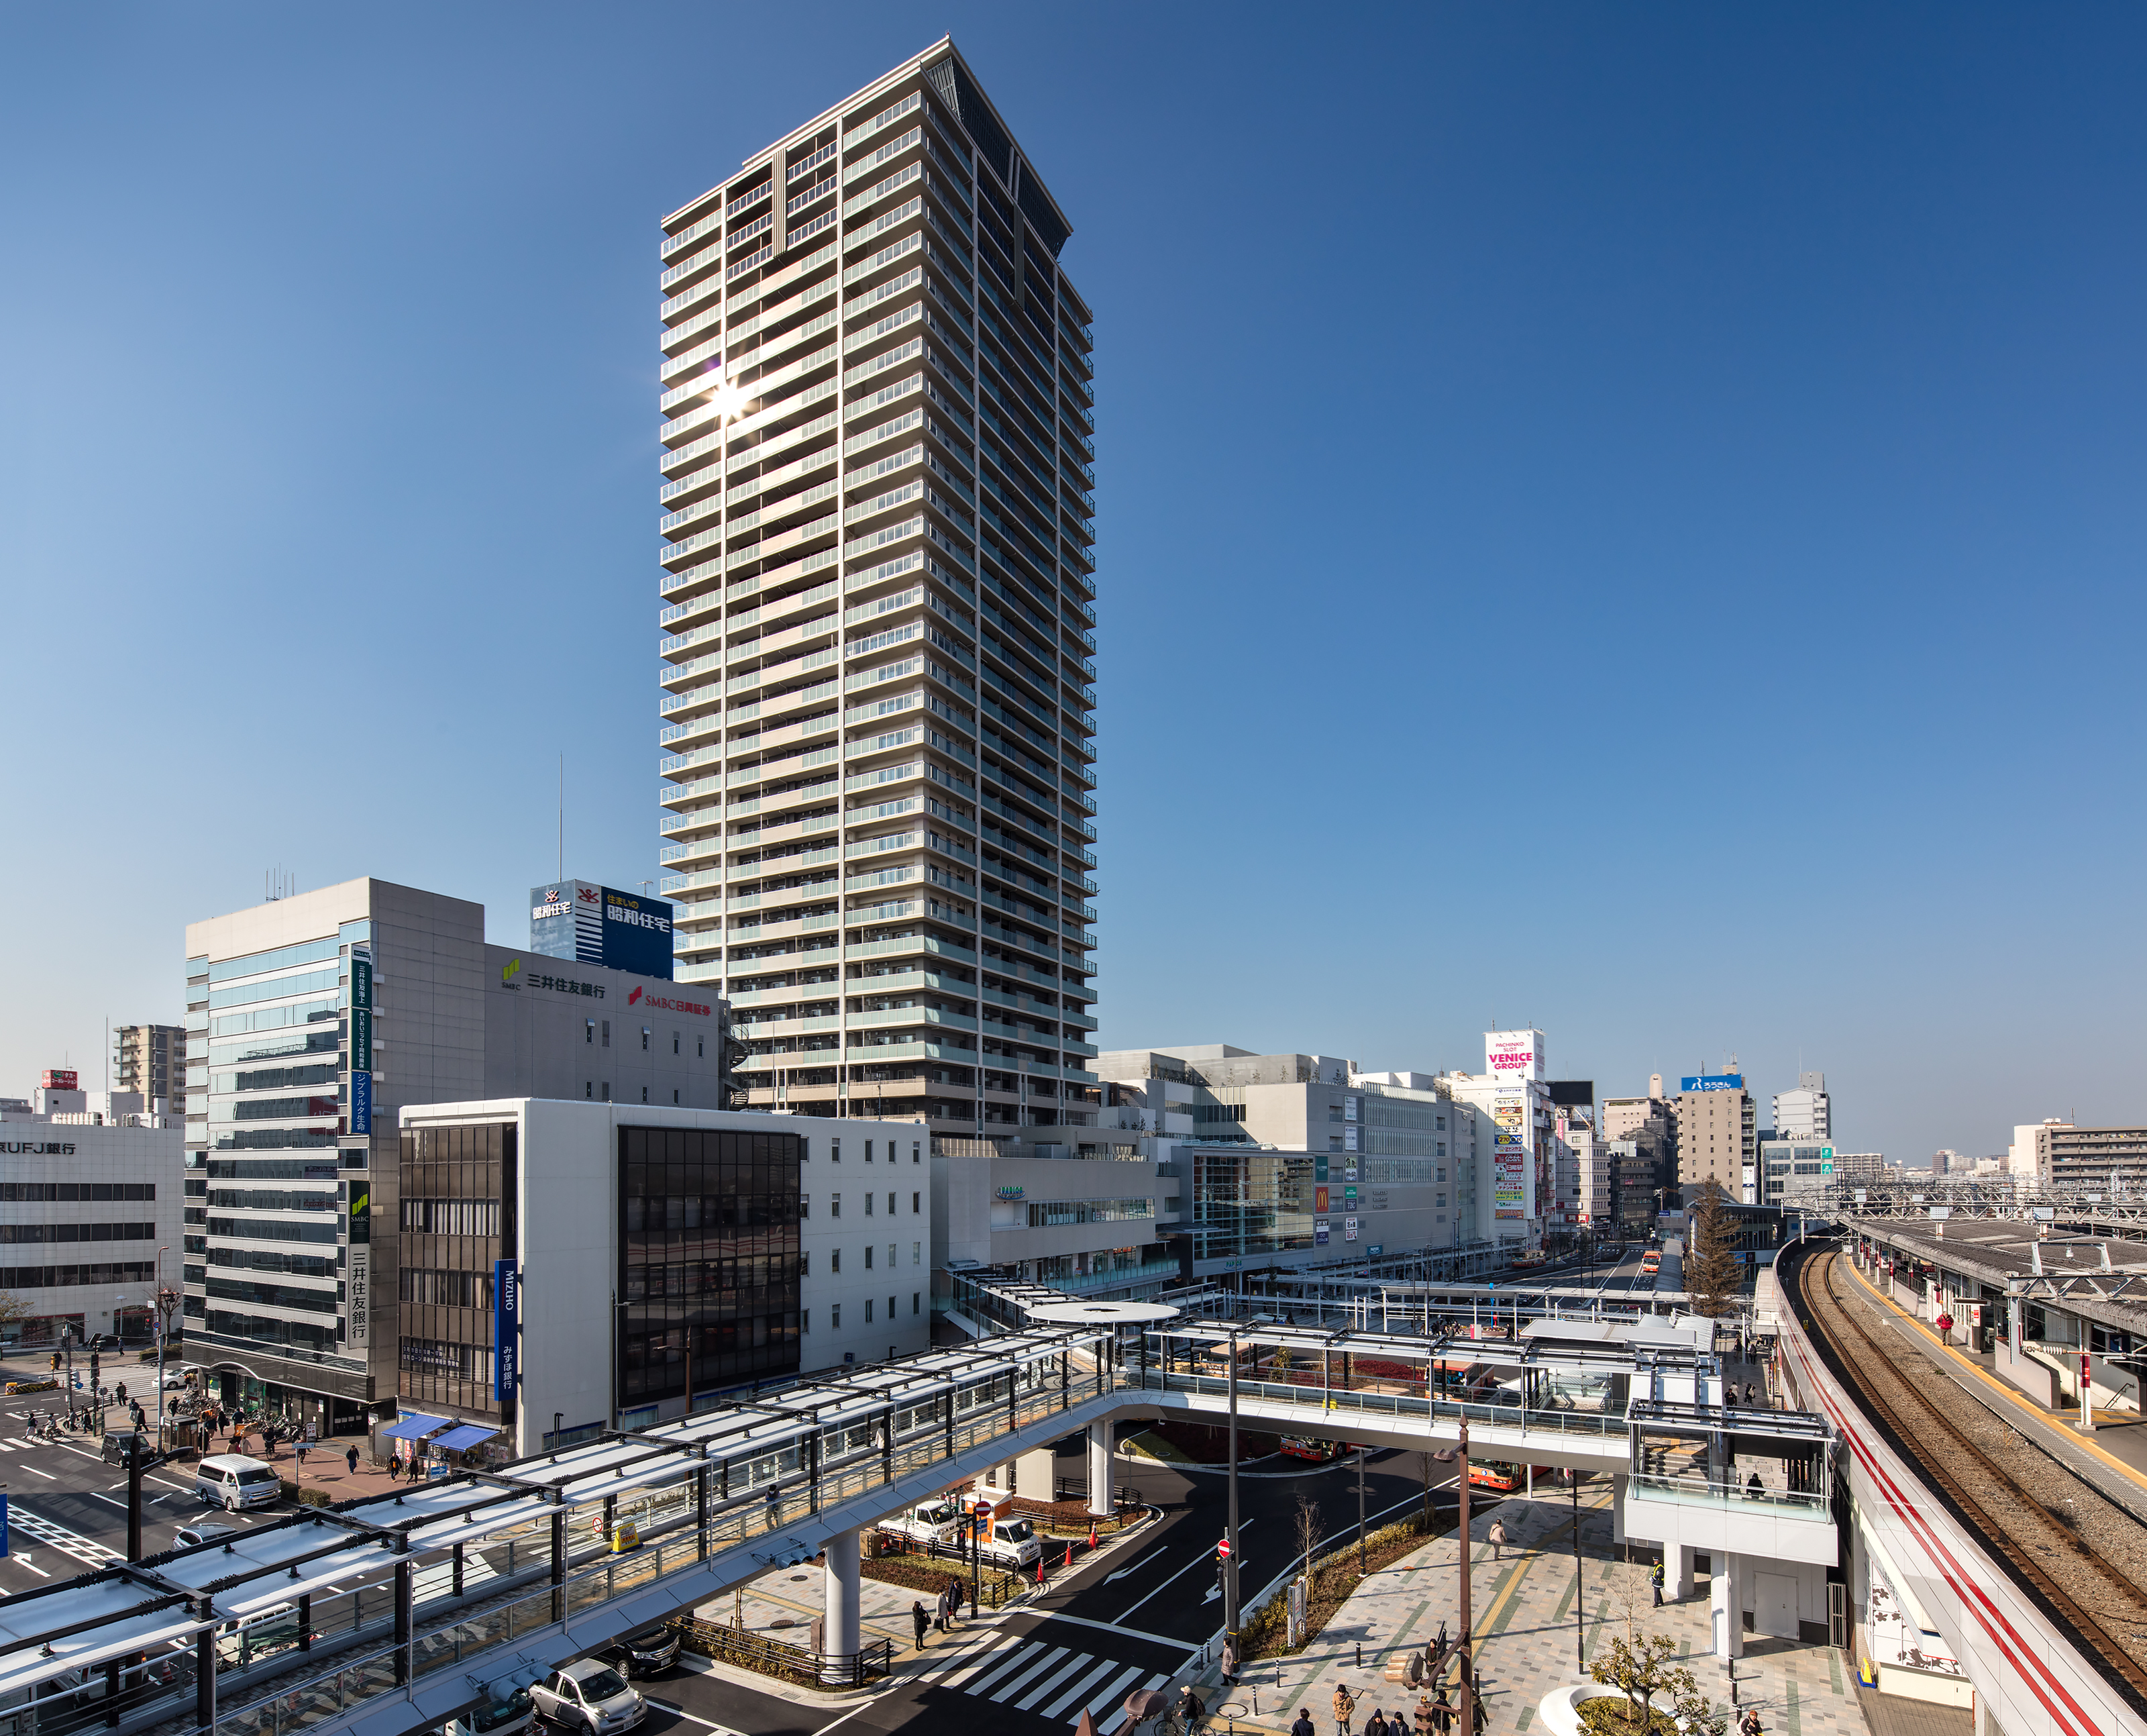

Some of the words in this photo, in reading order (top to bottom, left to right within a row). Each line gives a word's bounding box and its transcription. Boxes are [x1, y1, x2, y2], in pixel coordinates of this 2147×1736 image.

[533, 901, 571, 920] 昭和住宅
[607, 894, 639, 909] 住まいの
[608, 905, 670, 933] 昭和住宅
[527, 974, 605, 999] 三井住友銀行
[645, 994, 711, 1017] SMBC日興証券
[1489, 1052, 1532, 1063] VENICE
[357, 1074, 366, 1131] ジブラルタ生命
[352, 1253, 366, 1338] 三井住友銀行
[505, 1270, 514, 1311] MIZUHO
[2114, 1337, 2123, 1351] 1
[503, 1346, 513, 1389] みずほ銀行
